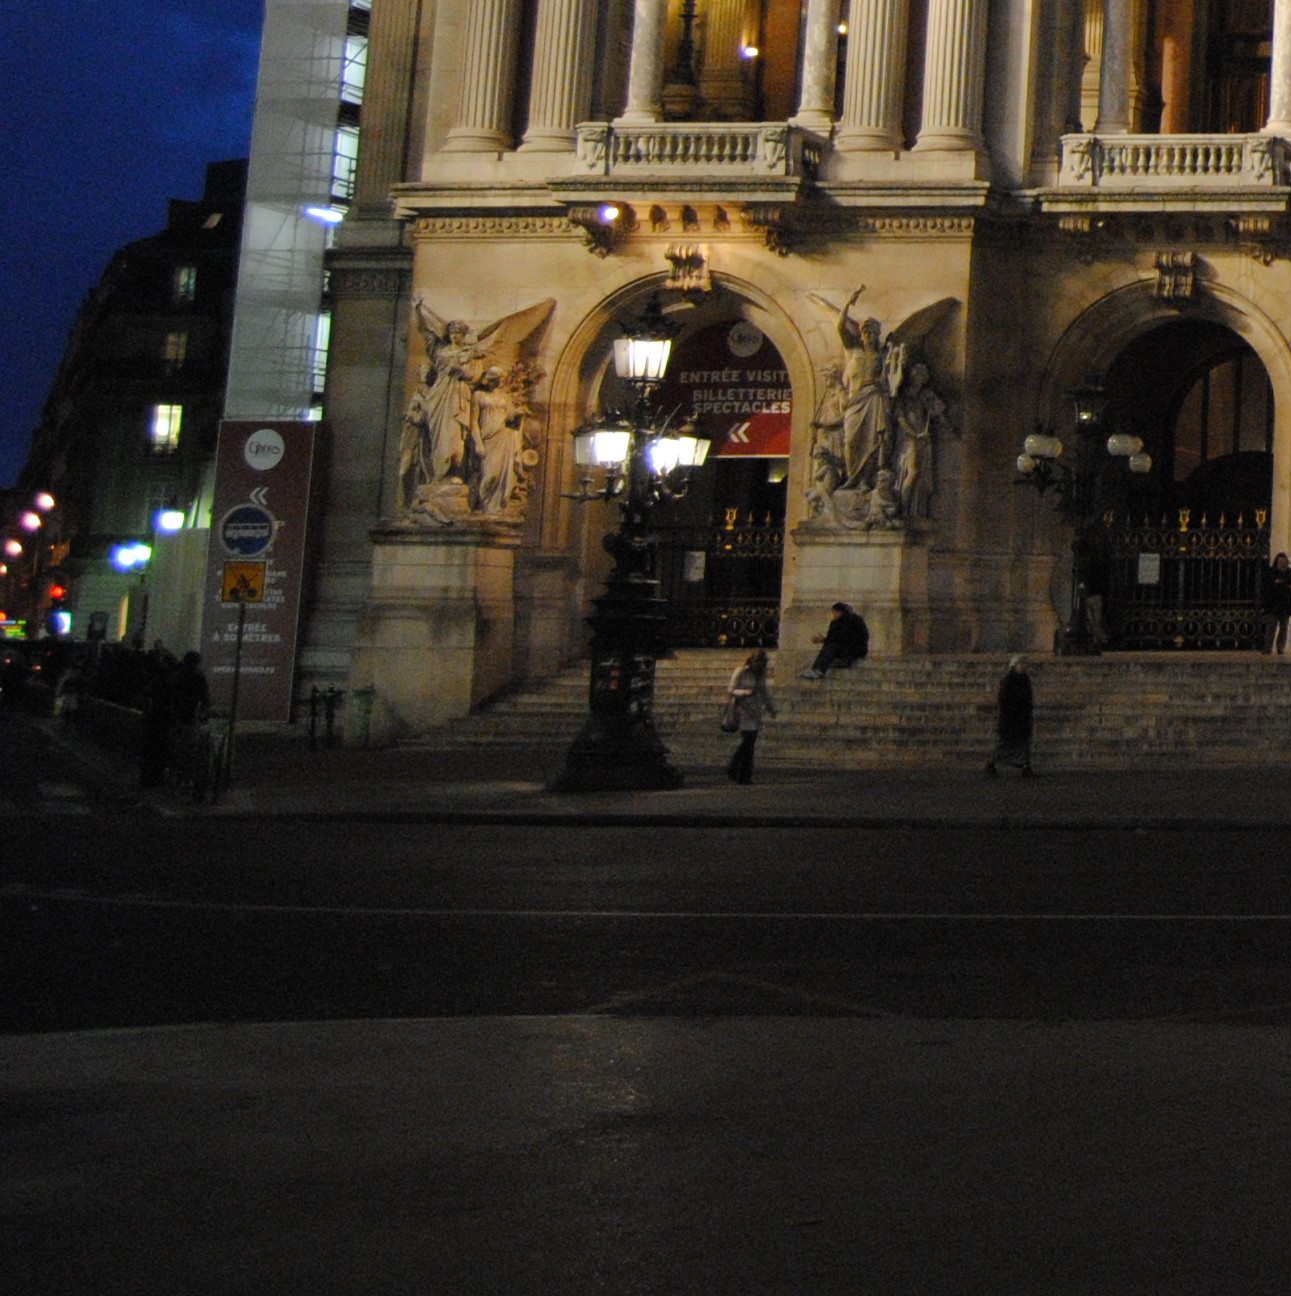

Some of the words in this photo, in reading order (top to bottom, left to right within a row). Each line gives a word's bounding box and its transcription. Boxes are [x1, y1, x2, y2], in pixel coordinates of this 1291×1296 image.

[680, 366, 741, 384] ENTRÉE
[692, 387, 792, 402] BILLETTERIE
[692, 400, 791, 414] SPECTACLES
